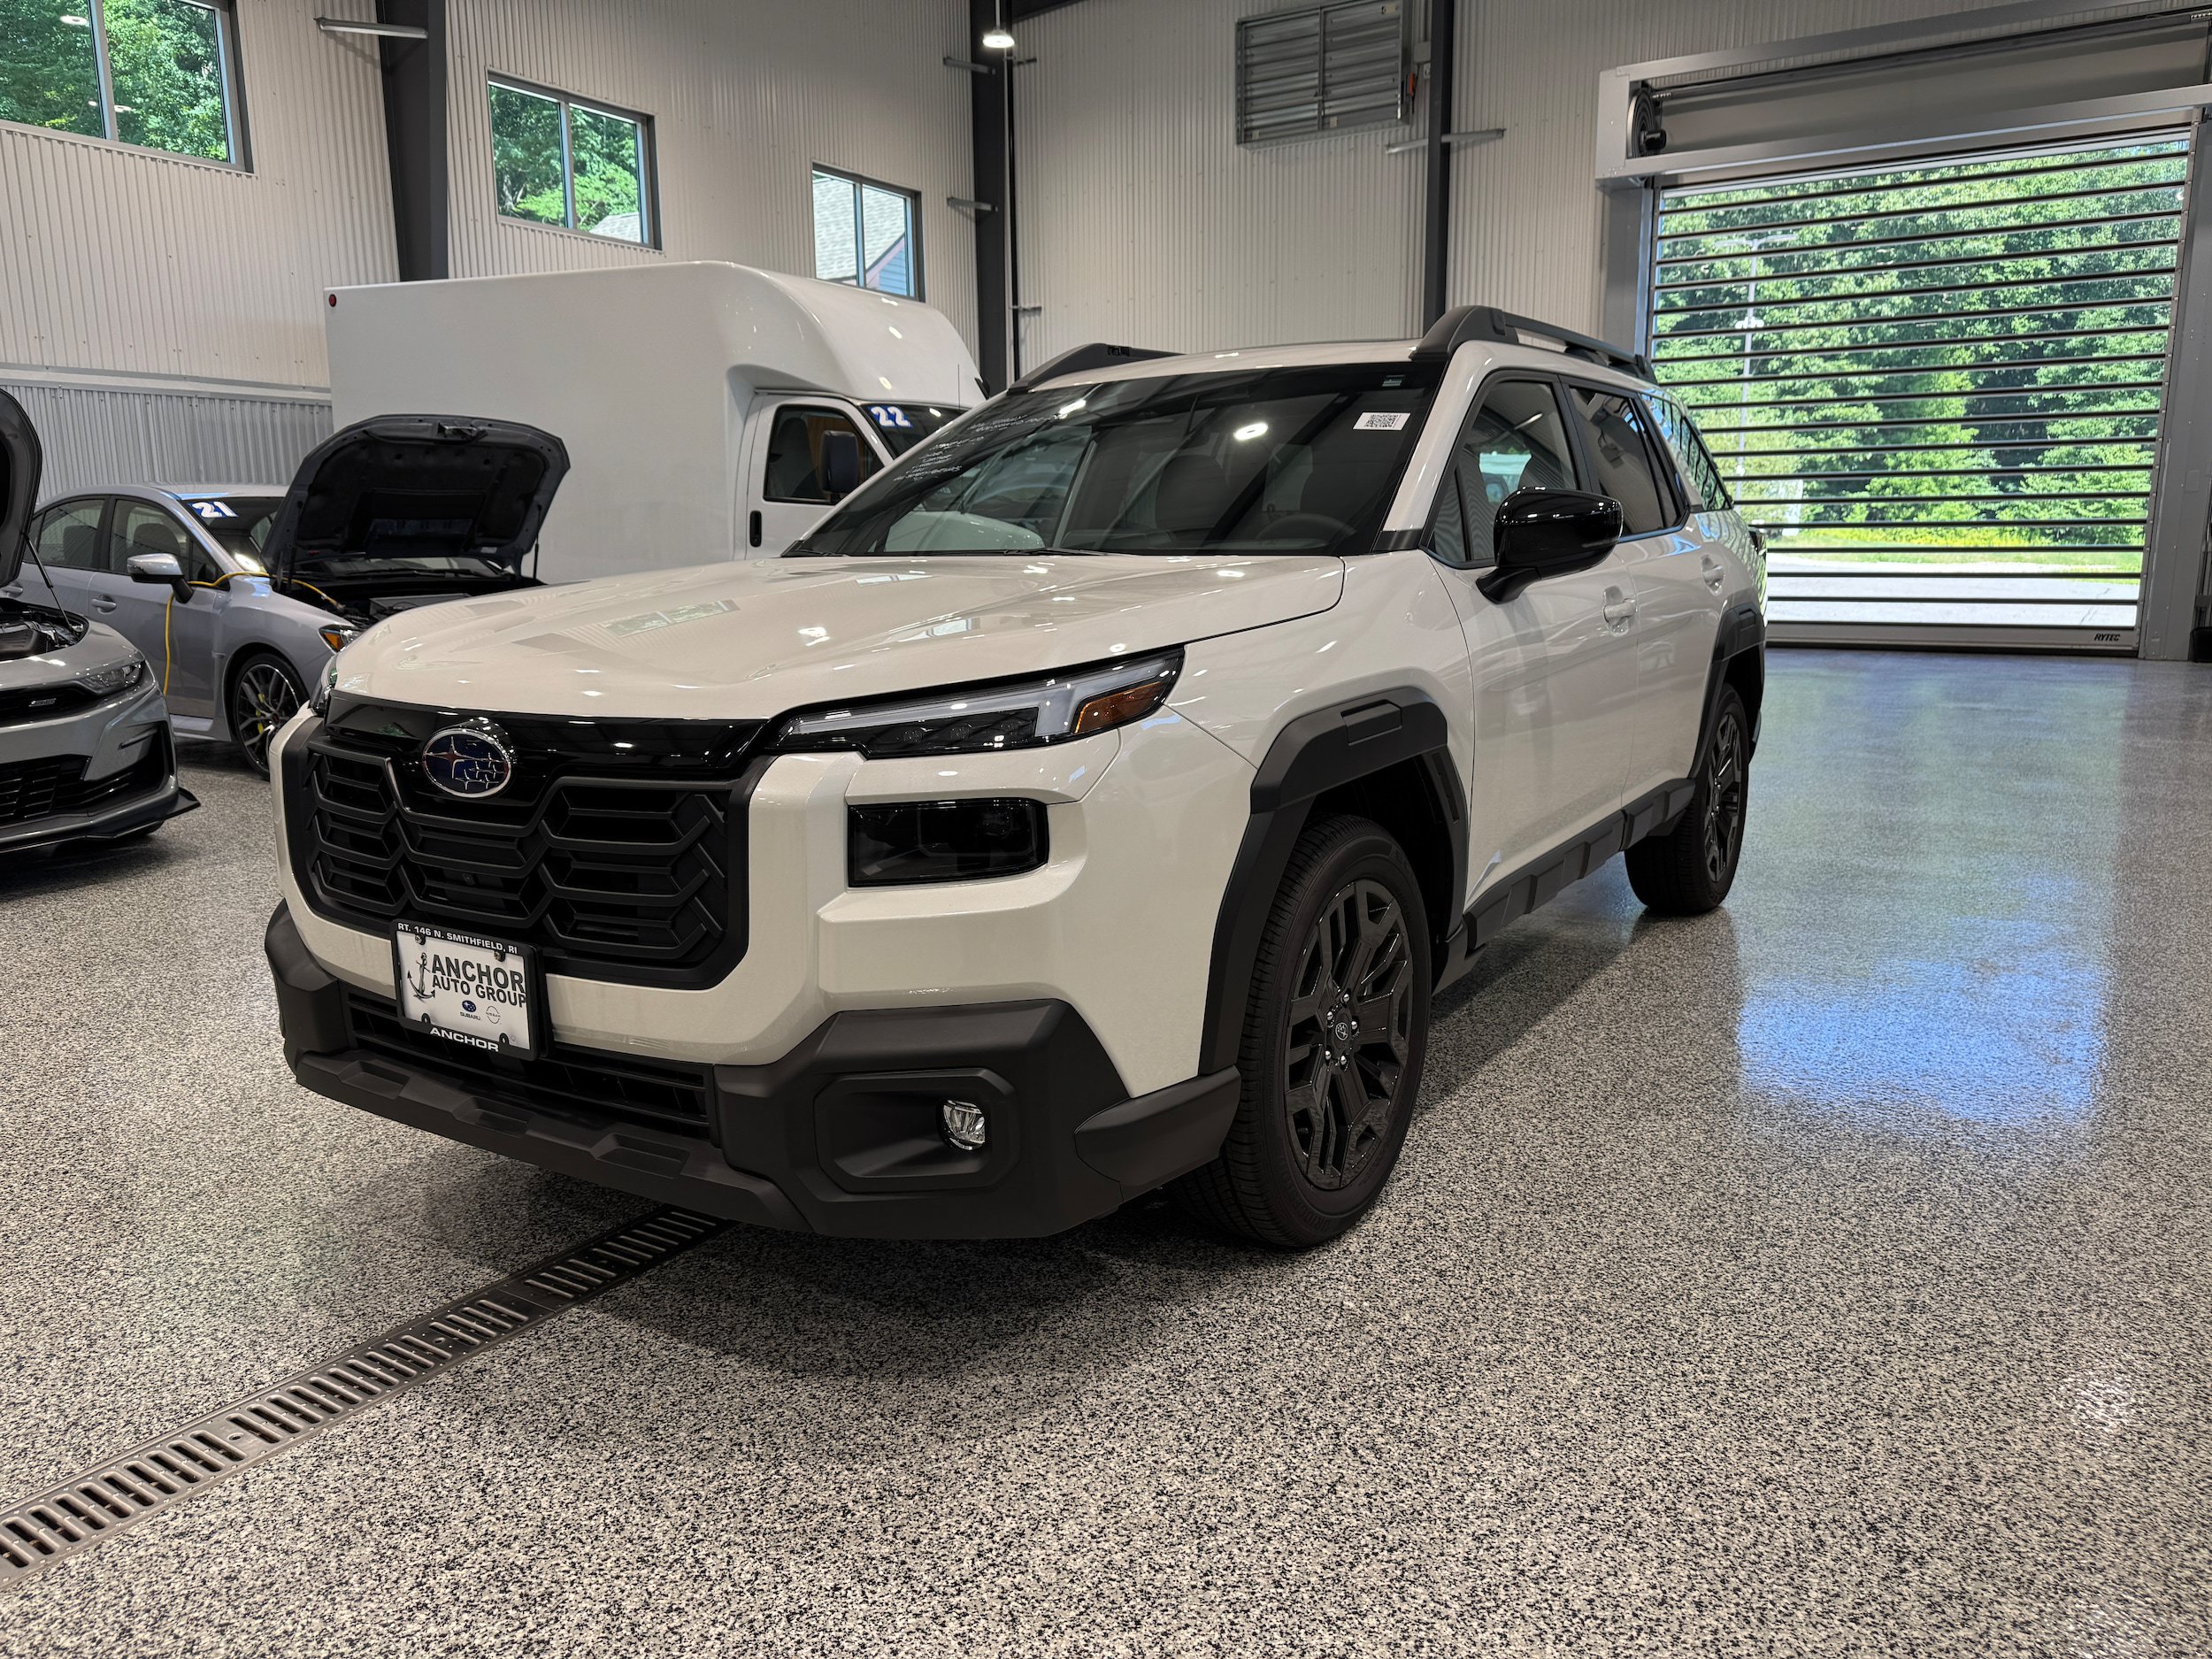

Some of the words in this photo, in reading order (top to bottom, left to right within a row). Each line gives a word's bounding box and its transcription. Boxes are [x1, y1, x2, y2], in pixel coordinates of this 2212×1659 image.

[870, 406, 911, 426] 22
[192, 501, 238, 518] 21
[2093, 633, 2121, 641] RYTEC
[397, 922, 411, 932] RT.
[414, 926, 432, 936] 146
[434, 929, 444, 939] N.
[446, 932, 506, 952] SMITHFIELD,
[508, 945, 518, 954] RI
[431, 954, 525, 993] ANCHOR
[432, 974, 471, 995] AUTO
[475, 984, 526, 1008] GROUP
[429, 1026, 499, 1053] ANCHOR
